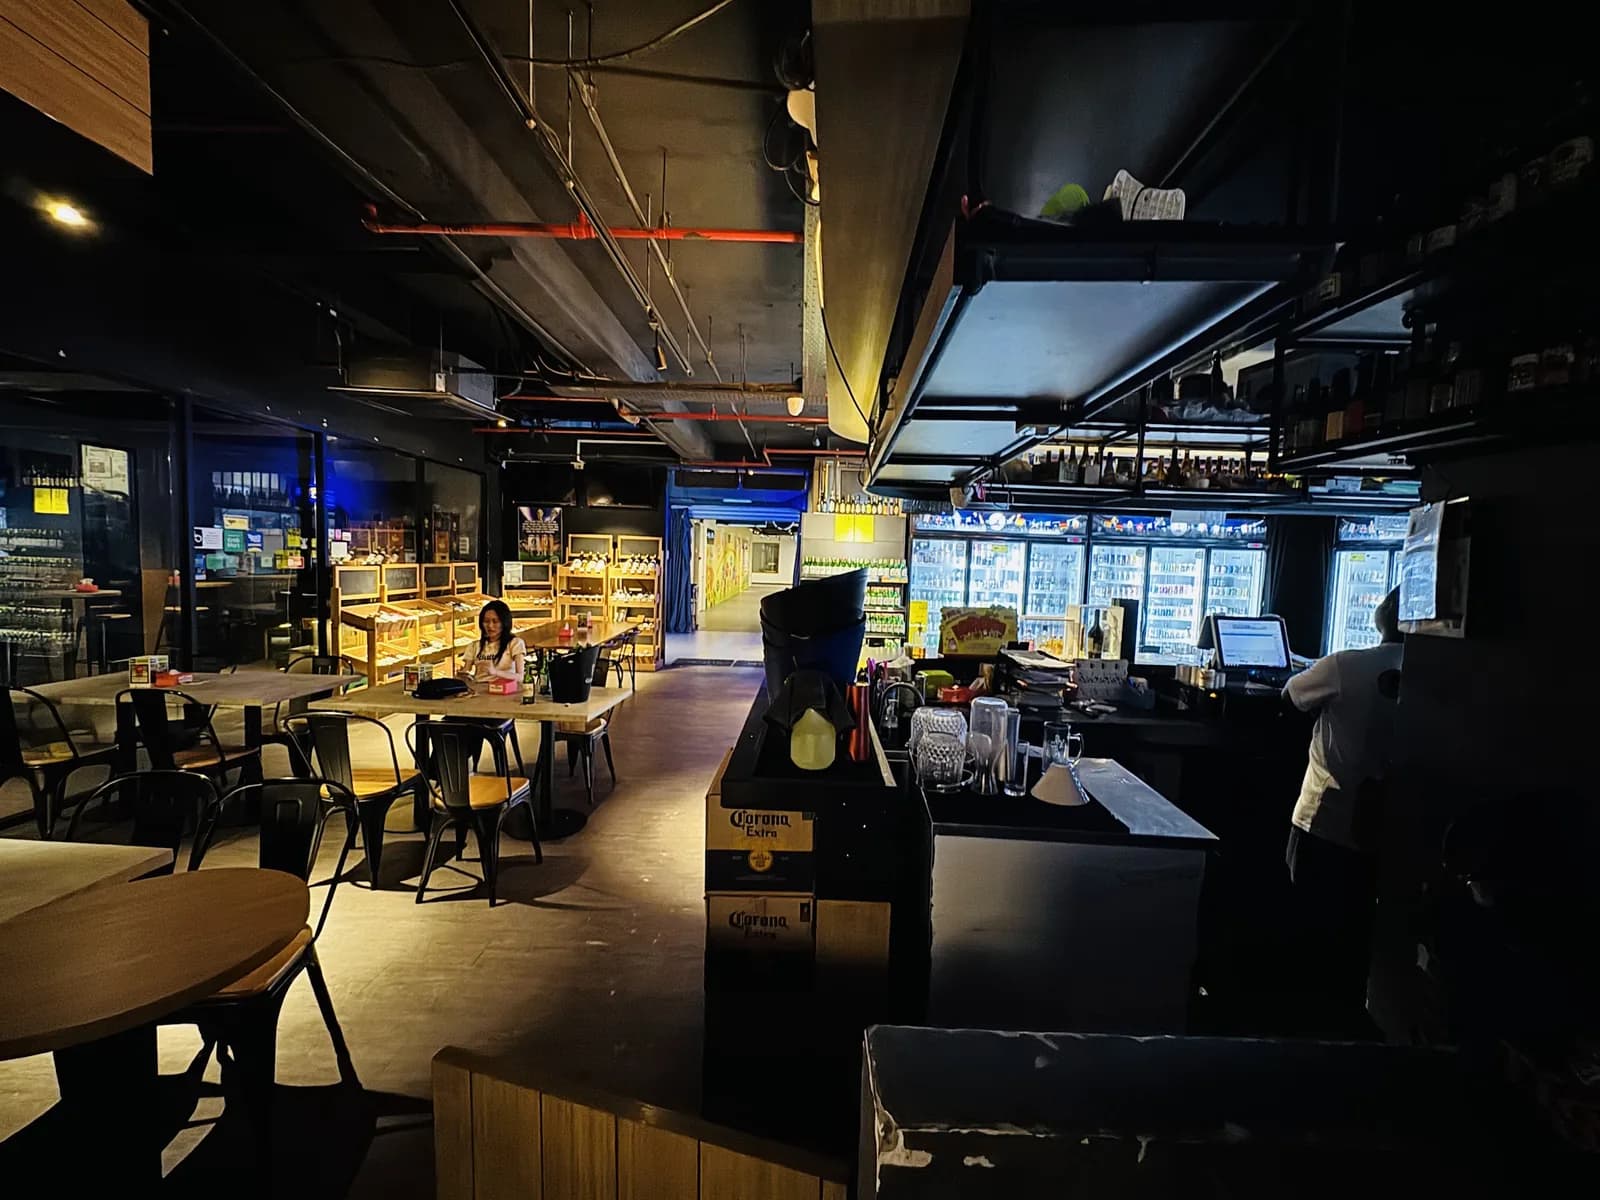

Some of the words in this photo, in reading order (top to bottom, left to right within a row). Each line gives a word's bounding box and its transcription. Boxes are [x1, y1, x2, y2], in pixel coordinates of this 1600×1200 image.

[730, 810, 791, 829] Corona
[746, 826, 777, 838] Extra
[729, 911, 789, 929] Corona
